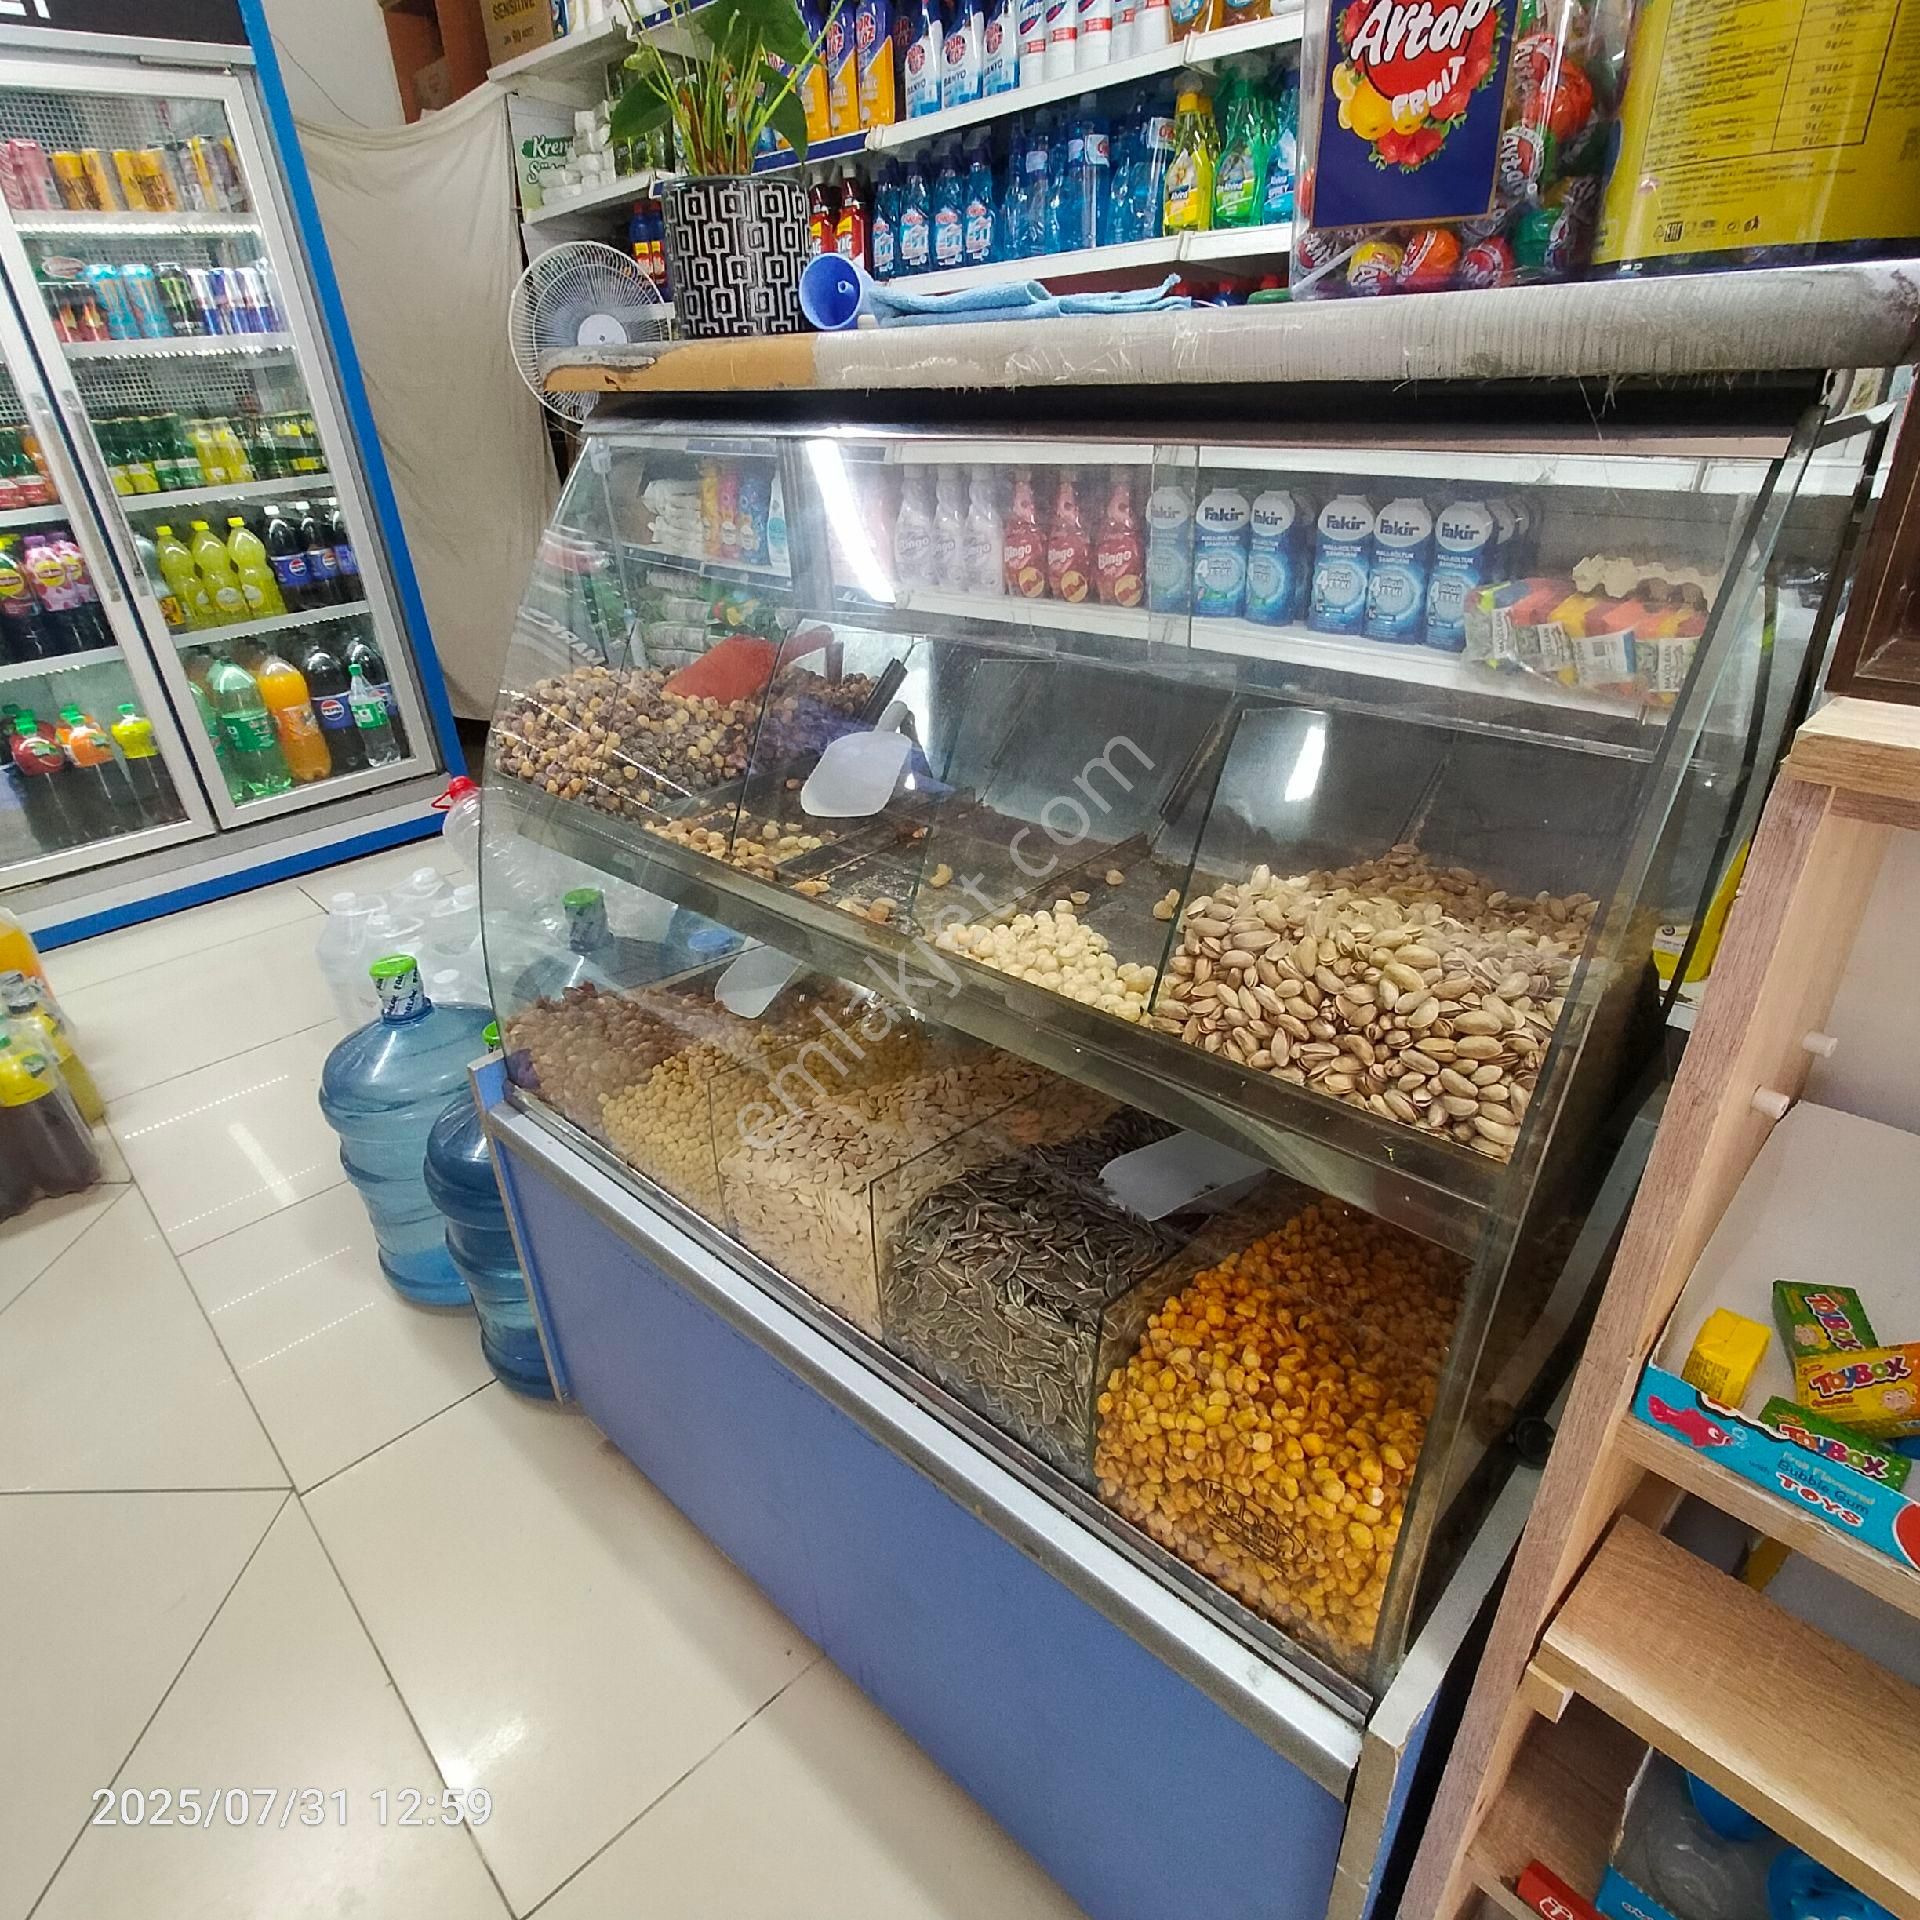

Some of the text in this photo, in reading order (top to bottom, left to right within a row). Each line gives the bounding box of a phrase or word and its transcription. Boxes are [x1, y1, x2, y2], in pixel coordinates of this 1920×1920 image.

[1391, 55, 1466, 121] FRUIT
[1204, 506, 1244, 522] Fakir
[1325, 514, 1366, 530] Fakir
[1379, 518, 1420, 537] Fakir
[1441, 521, 1480, 541] Fakir
[1003, 544, 1032, 563] Bingo
[1047, 547, 1074, 566] Bingo
[1097, 550, 1132, 570] Bingo
[1316, 569, 1329, 590] 4
[1369, 575, 1381, 597] 4
[1430, 581, 1440, 602] 4
[1805, 1294, 1865, 1351] TOYBOX
[1808, 1355, 1911, 1398] TOYBOX
[1779, 1424, 1889, 1479] TOYBOX
[1777, 1458, 1869, 1515] Bubble Gum
[1775, 1471, 1864, 1528] TOYS
